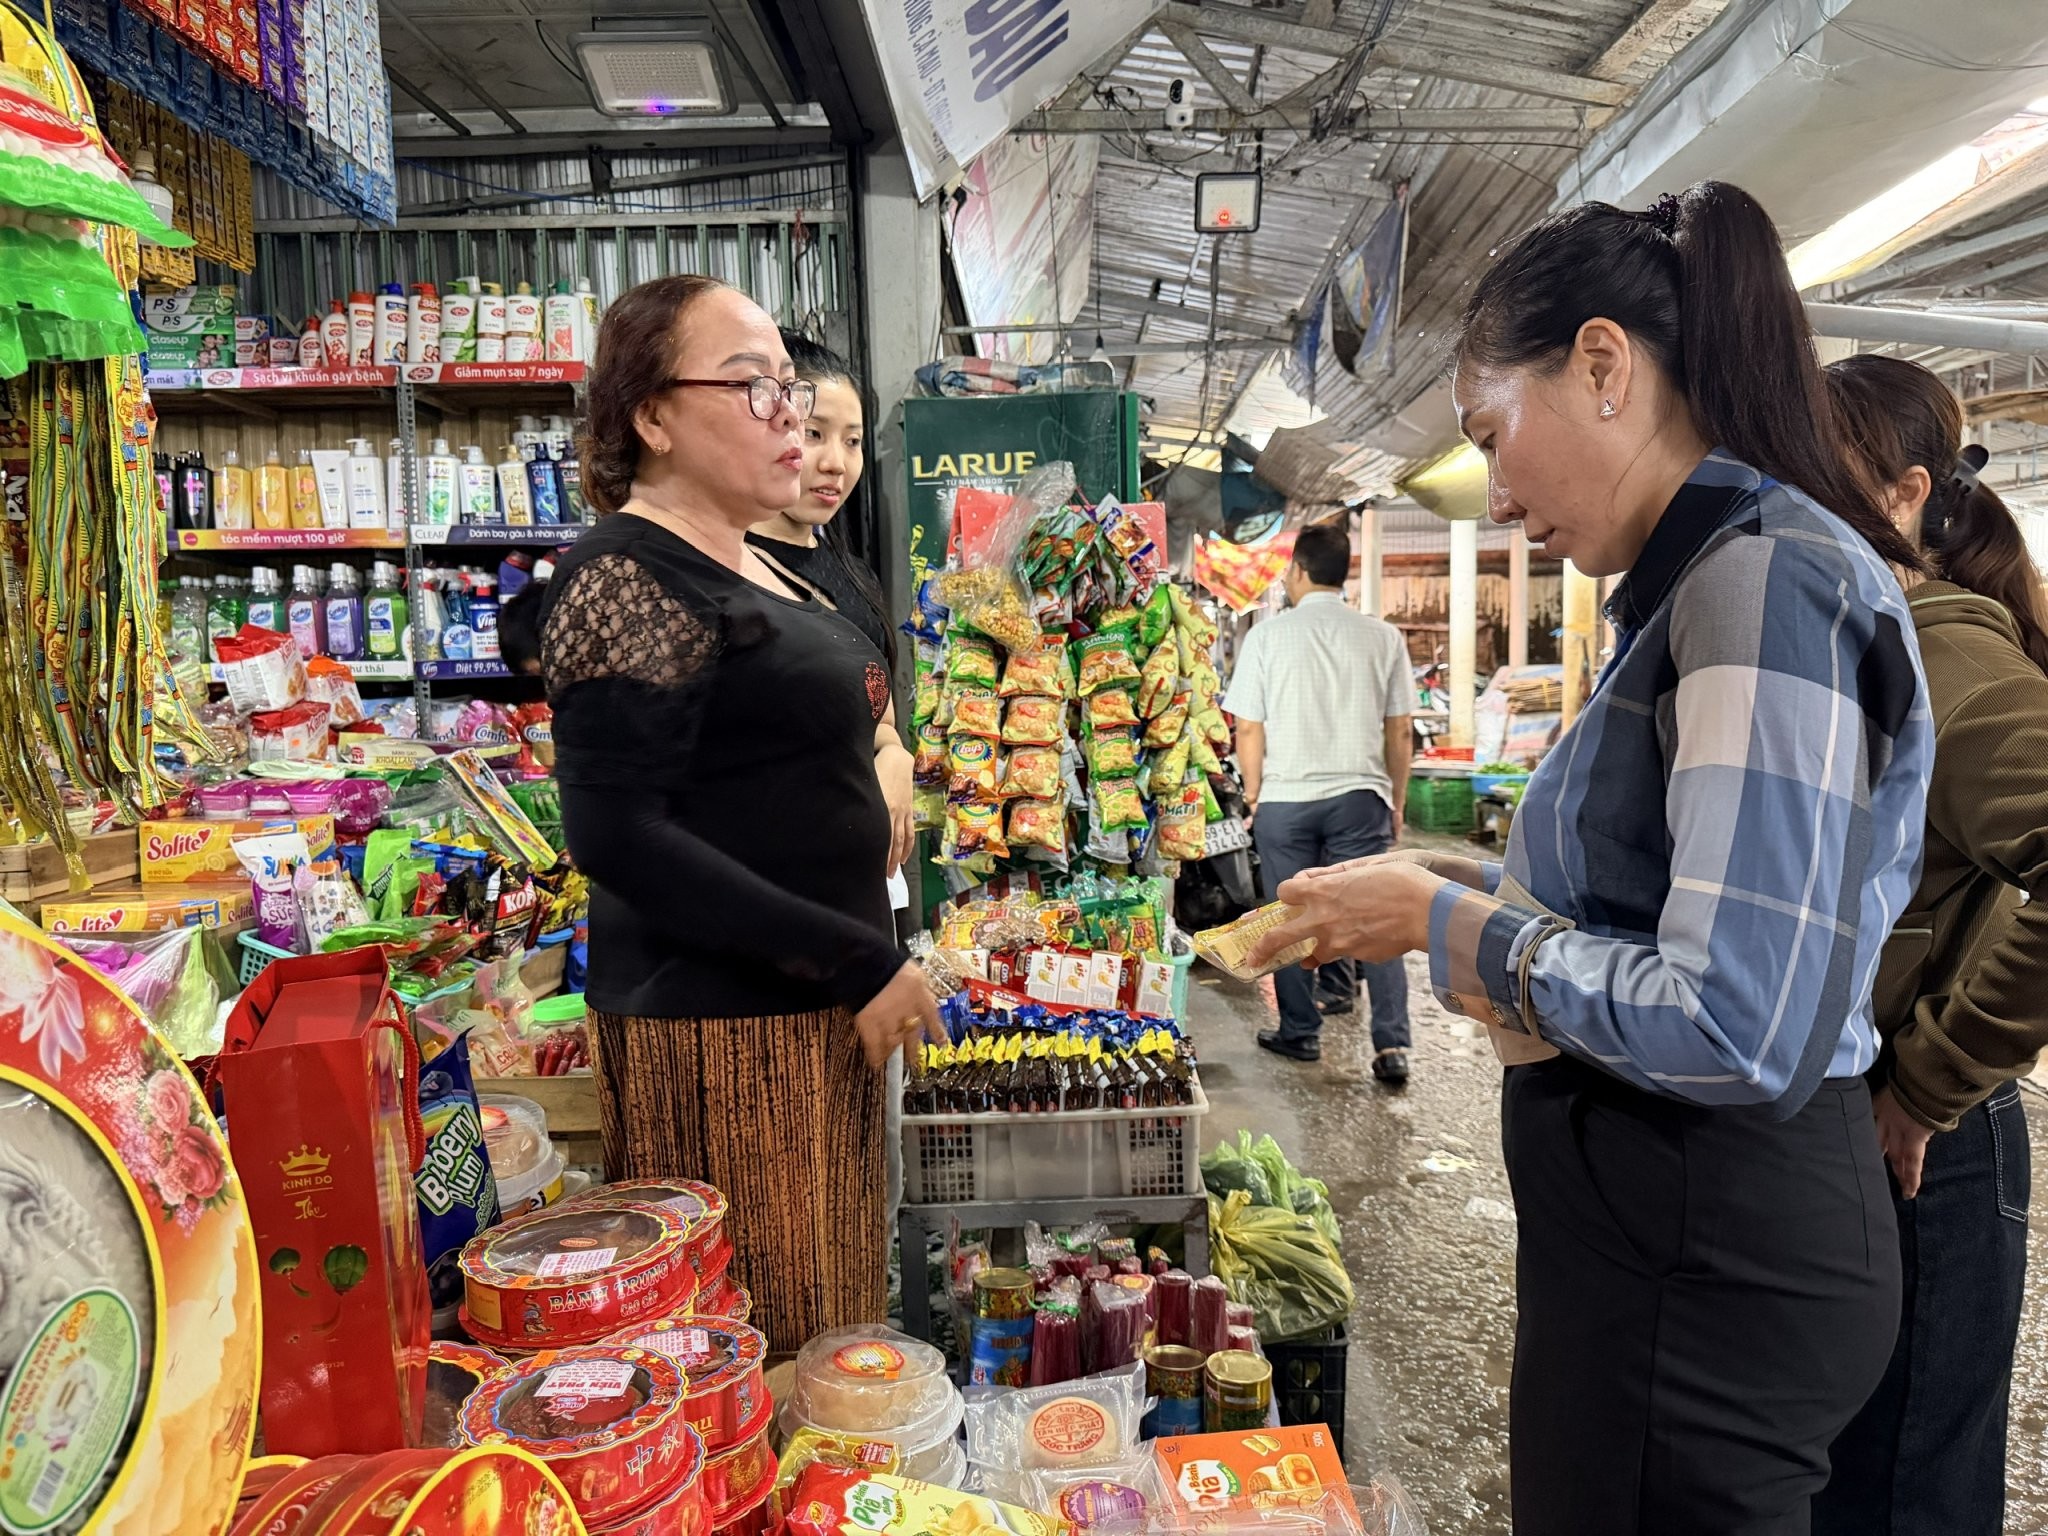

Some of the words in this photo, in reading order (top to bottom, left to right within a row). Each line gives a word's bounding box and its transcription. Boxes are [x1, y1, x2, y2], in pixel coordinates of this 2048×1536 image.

[916, 45, 941, 80] MAU
[150, 335, 189, 346] closeup
[252, 371, 283, 385] Sạch
[283, 371, 293, 382] vi
[295, 369, 331, 383] khuẩn
[333, 369, 352, 385] gây
[354, 369, 384, 384] bệnh
[454, 364, 481, 378] Giảm
[482, 367, 506, 382] mụn
[507, 367, 527, 378] sau
[529, 366, 536, 378] 7
[538, 366, 564, 380] ngày
[911, 451, 1037, 479] LARUE
[220, 532, 240, 544] tóc
[242, 531, 271, 544] mềm
[273, 532, 303, 545] mượt
[305, 533, 325, 543] 100
[328, 532, 346, 546] giờ
[414, 529, 446, 539] CLEAR
[491, 529, 509, 540] bay
[365, 662, 385, 673] thái
[422, 663, 438, 676] Vim
[455, 662, 473, 674] Diệt
[474, 662, 499, 674] 99,9%
[306, 711, 327, 736] Karo
[959, 742, 985, 755] Lay's
[145, 836, 203, 863] Solite
[1001, 962, 1010, 985] COSY
[281, 1177, 312, 1191] KINH
[314, 1174, 333, 1186] DO
[548, 1284, 610, 1314] BÁNH
[613, 1260, 669, 1299] TRUNG
[620, 1301, 641, 1317] CAO
[1189, 1463, 1197, 1488] Bánh
